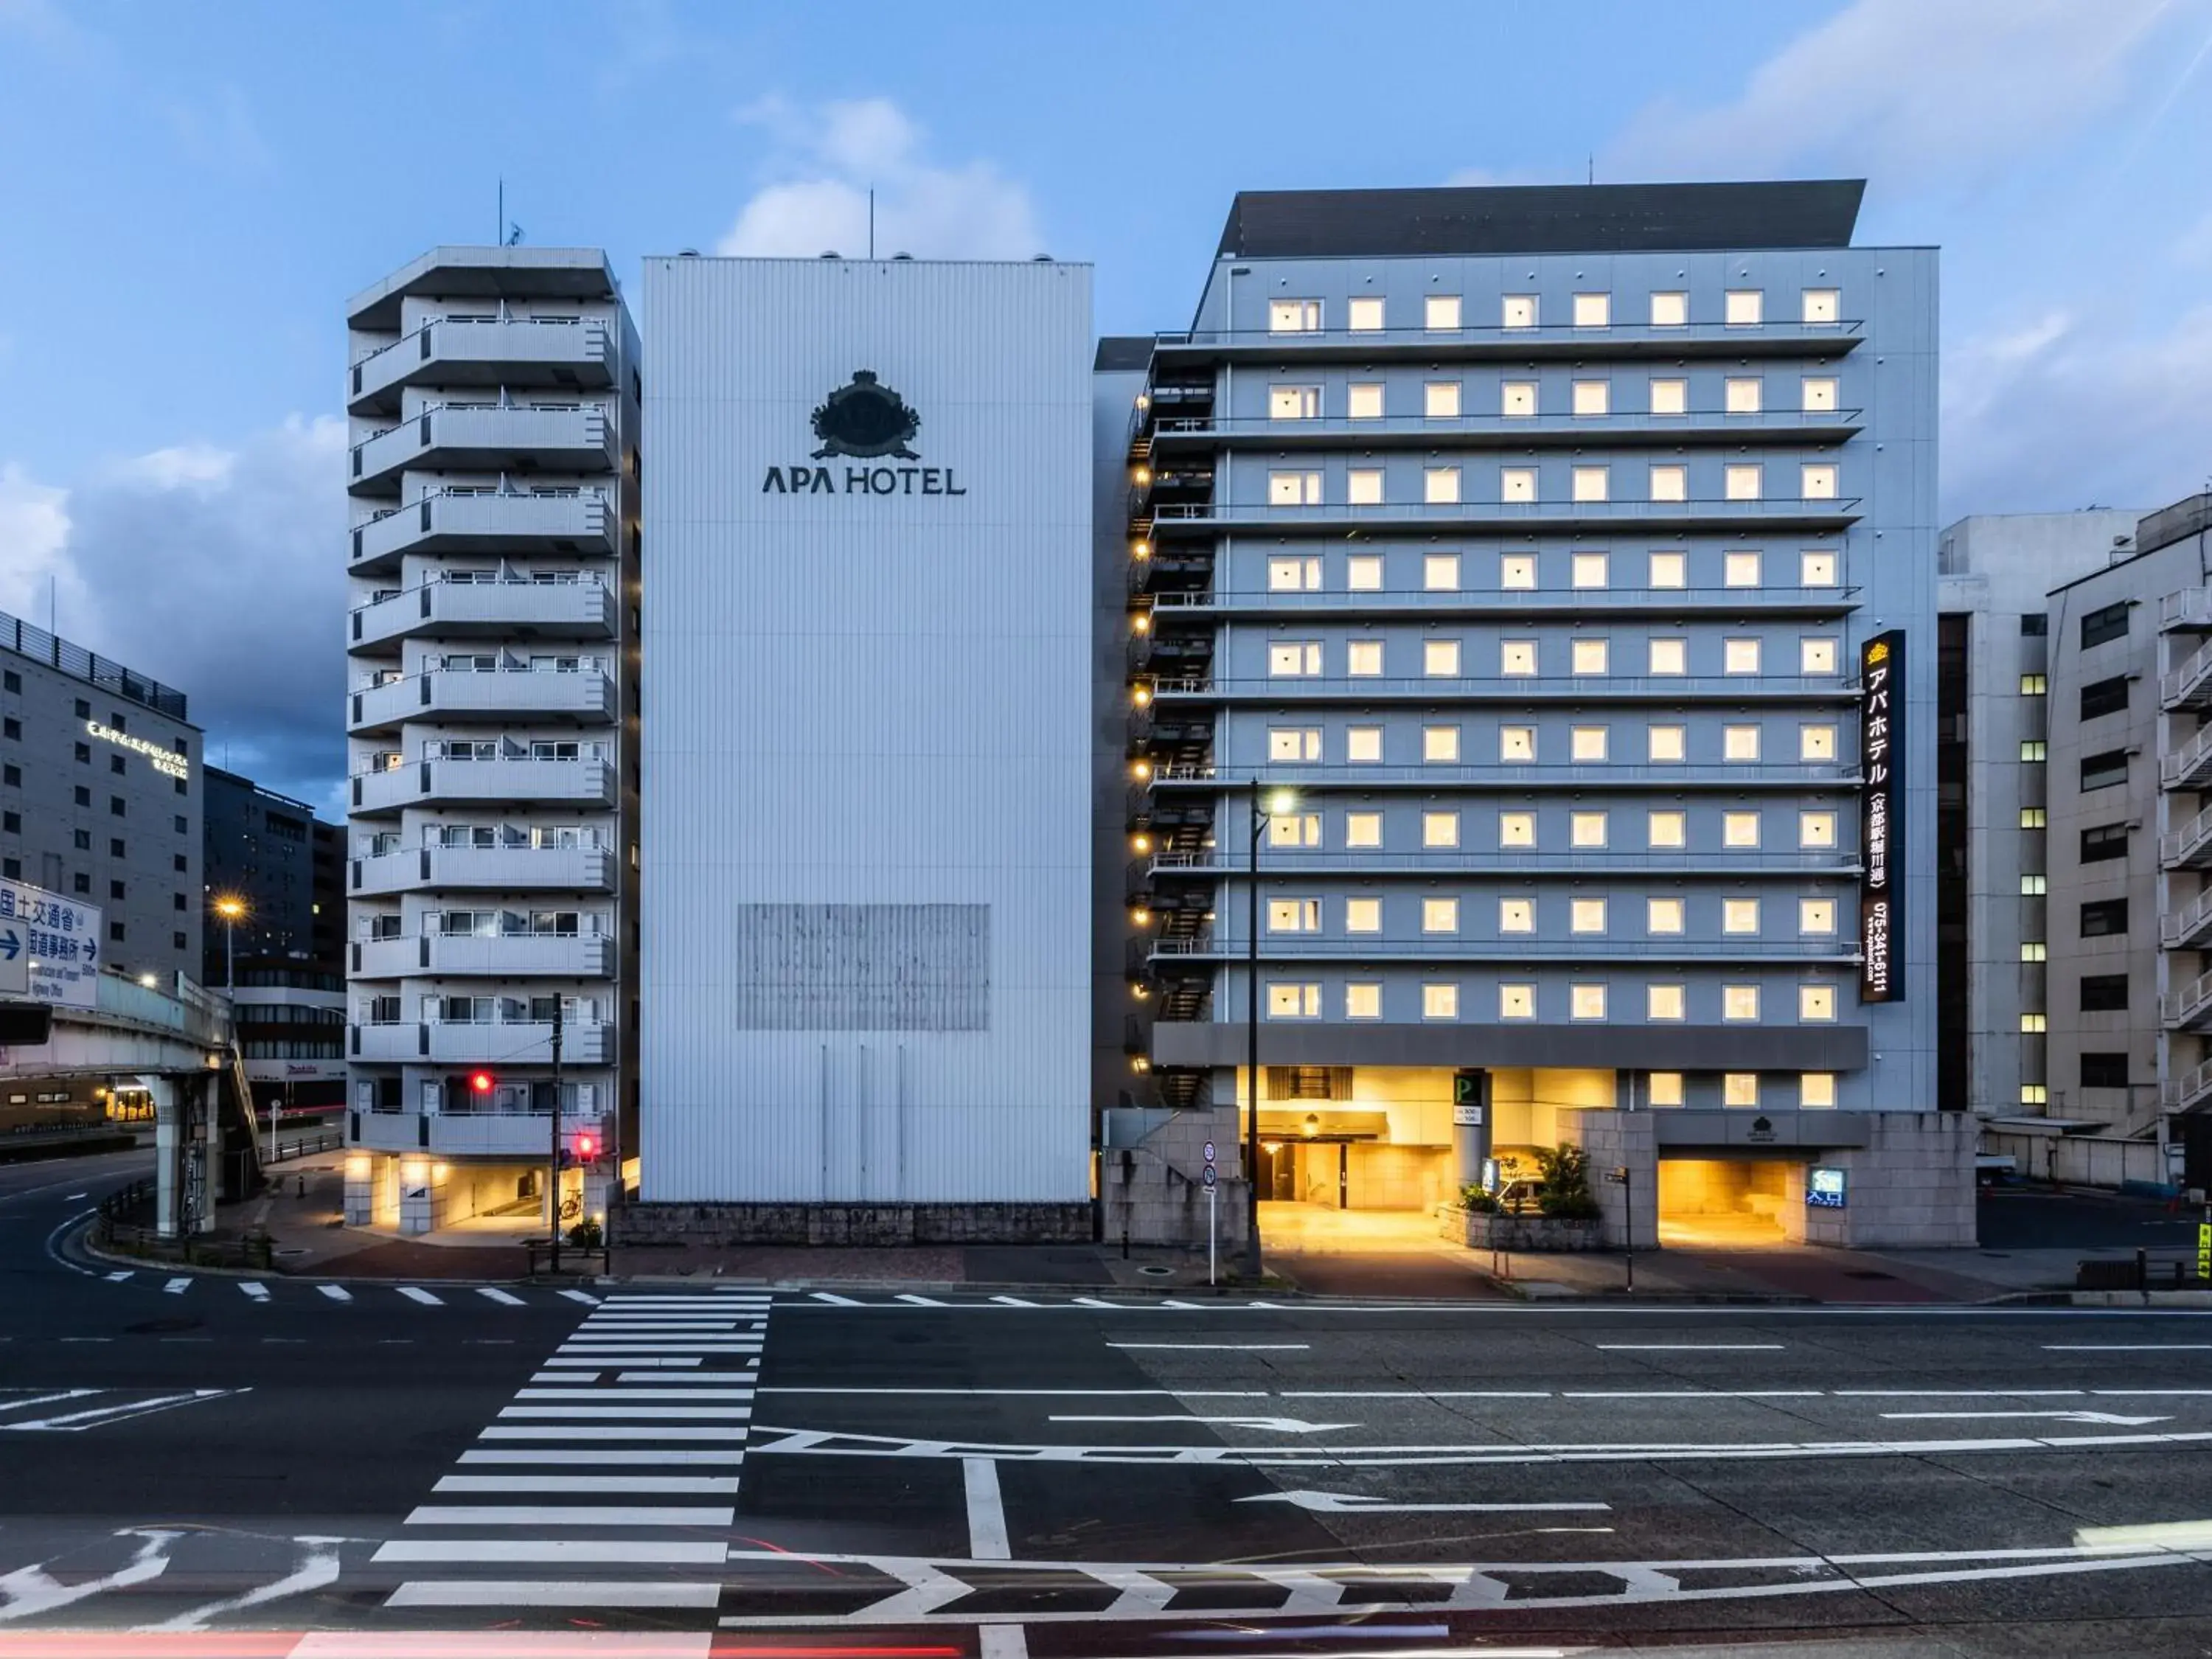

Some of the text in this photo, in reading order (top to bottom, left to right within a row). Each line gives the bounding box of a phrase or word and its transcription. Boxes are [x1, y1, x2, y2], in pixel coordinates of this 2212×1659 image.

[762, 467, 967, 495] APA HOTEL
[1868, 667, 1888, 785] アパホテル
[1, 888, 74, 932] 国土交通省
[1874, 902, 1888, 992] 075-341-6111
[1456, 1078, 1472, 1102] P
[1807, 1191, 1842, 1201] 入口
